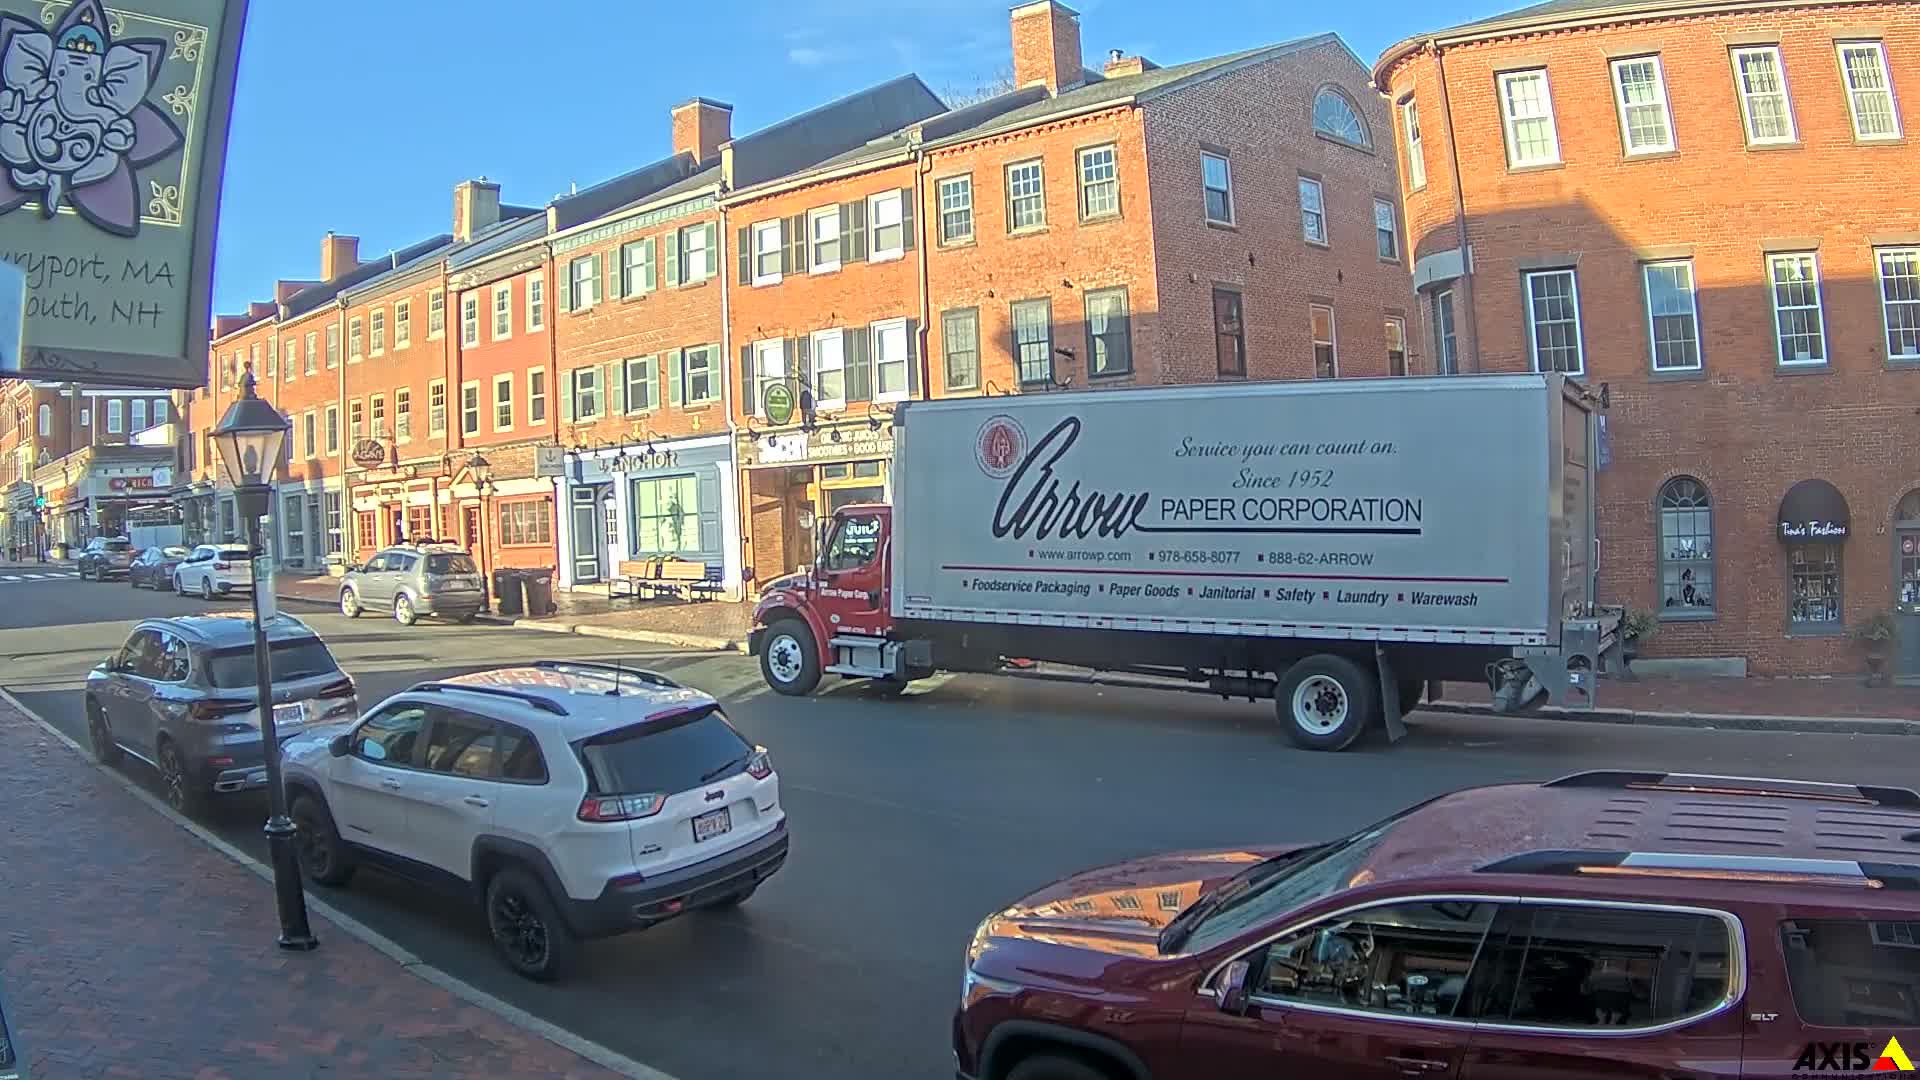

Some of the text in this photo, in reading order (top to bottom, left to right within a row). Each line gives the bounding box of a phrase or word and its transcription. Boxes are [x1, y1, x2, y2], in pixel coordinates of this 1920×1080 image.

[121, 260, 176, 288] MA
[111, 300, 163, 328] NH
[1175, 436, 1398, 463] Service you can count on.
[992, 416, 1151, 541] Arrow
[1232, 468, 1335, 489] Since 1952
[1161, 498, 1423, 523] PAPER CORPORATION
[1782, 521, 1806, 536] Tina's
[1038, 550, 1374, 566] www.arrowp.com 978-658-8077 888-62-ARROW
[972, 577, 1478, 607] Foodservice Packaging Paper Goods Janitorial Safety Laundry Warewash
